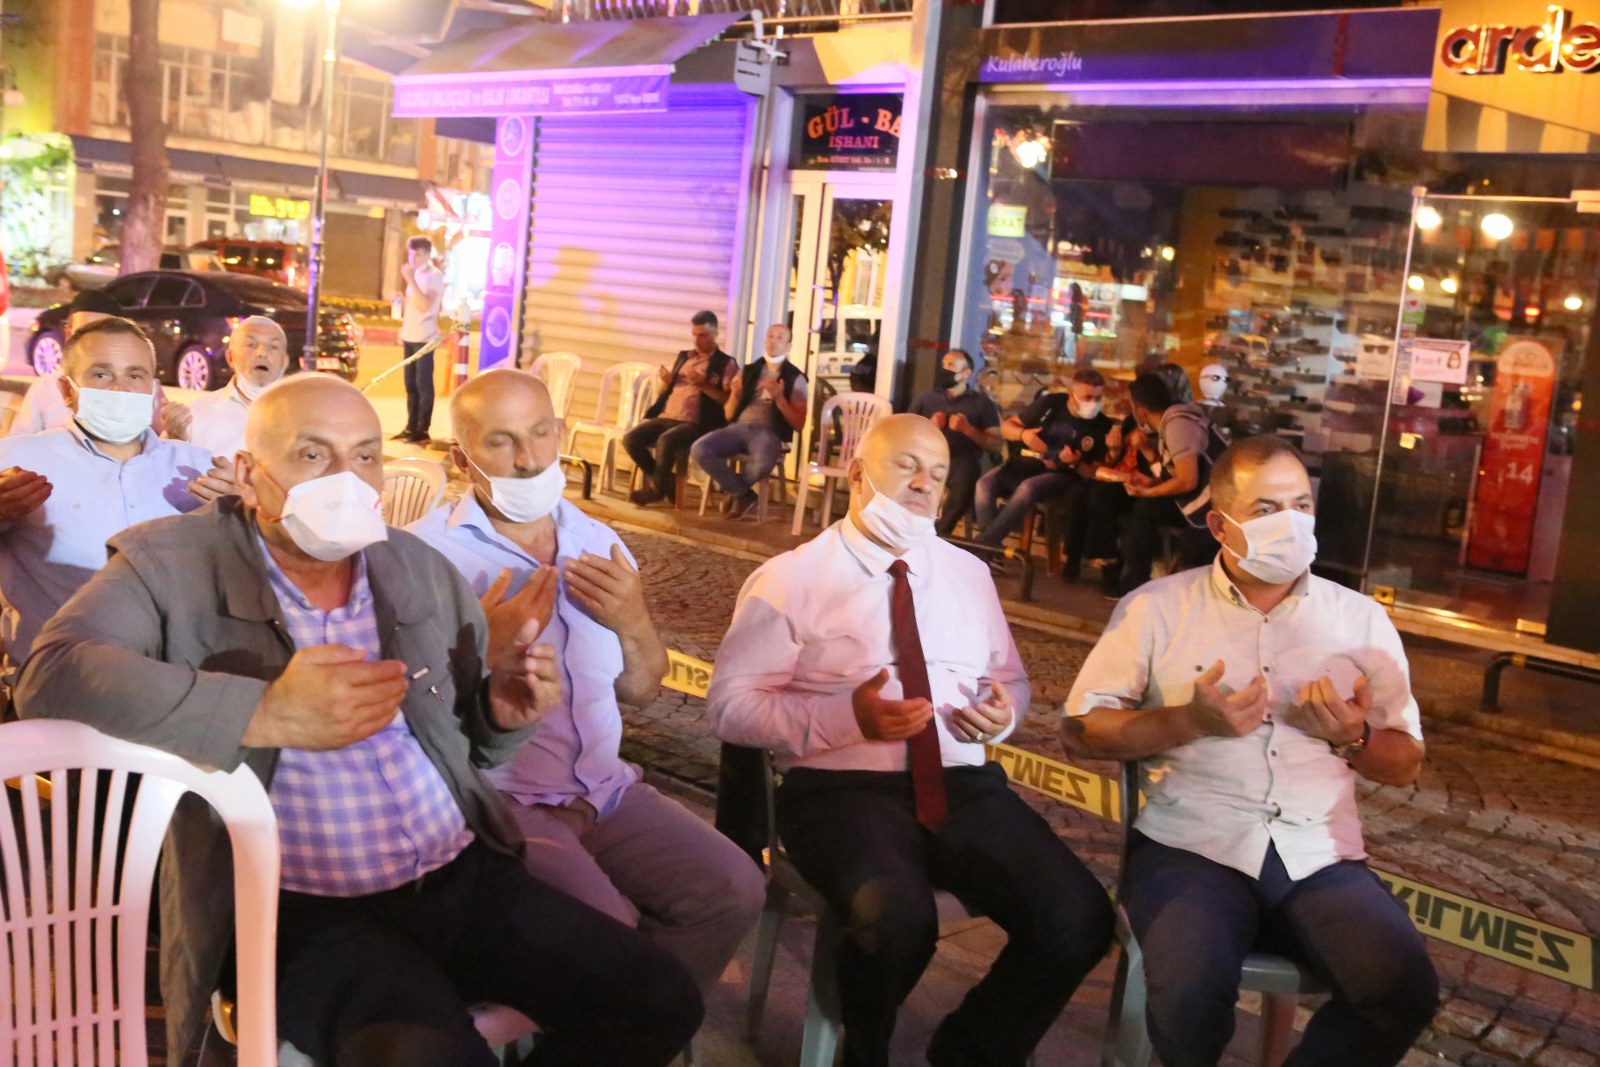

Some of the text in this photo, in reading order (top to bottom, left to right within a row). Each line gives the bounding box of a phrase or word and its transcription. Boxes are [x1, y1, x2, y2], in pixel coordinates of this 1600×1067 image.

[1441, 5, 1600, 74] arde
[987, 51, 1082, 77] Kulaberoğlu
[807, 104, 854, 139] GÜL
[1506, 462, 1534, 485] 14
